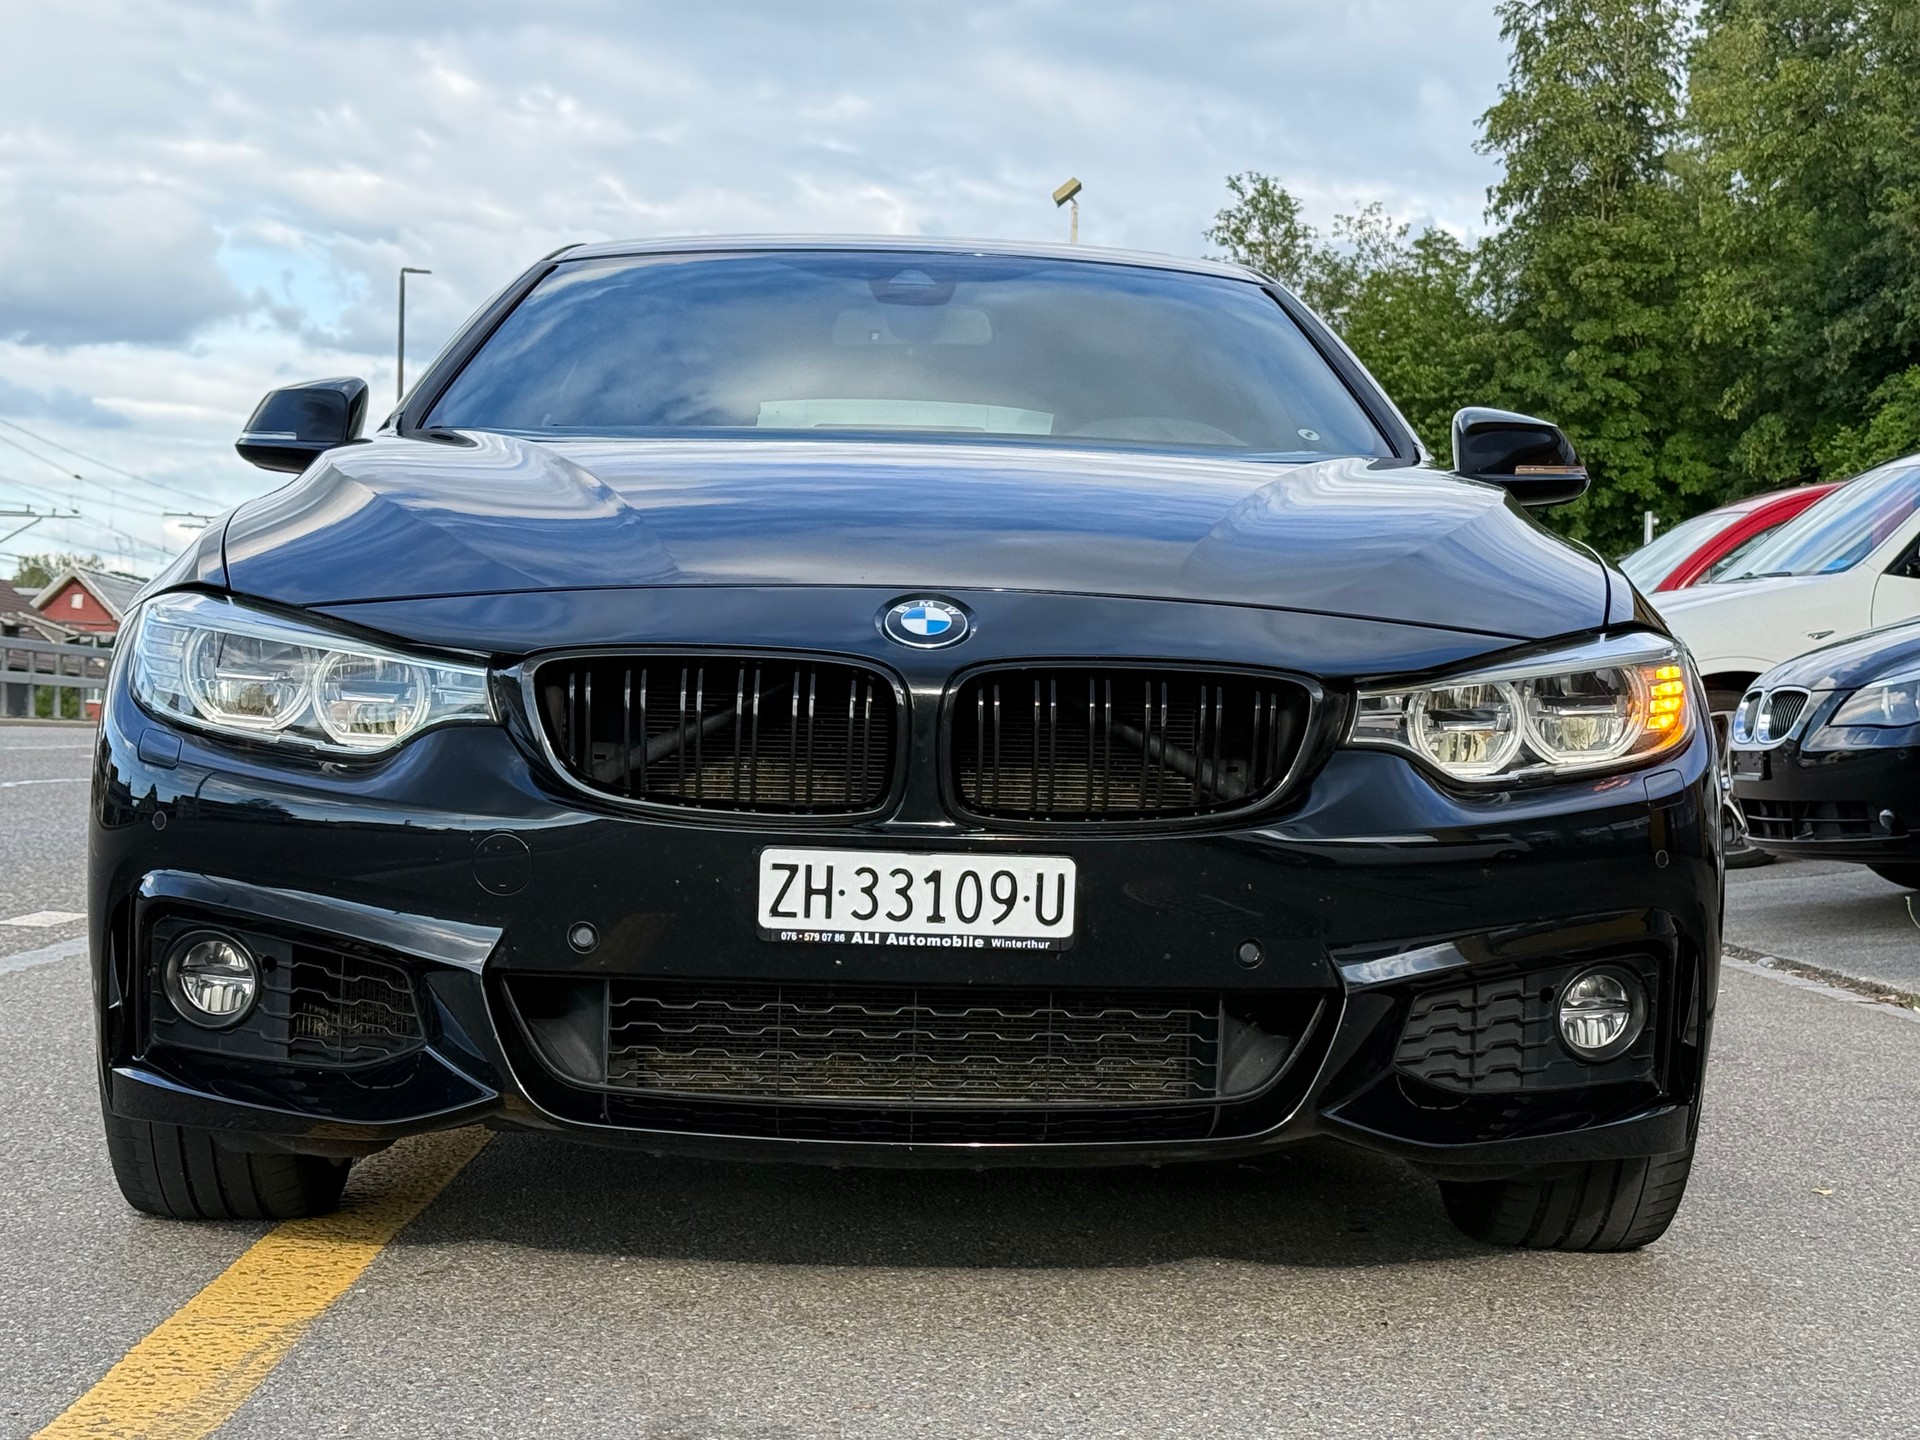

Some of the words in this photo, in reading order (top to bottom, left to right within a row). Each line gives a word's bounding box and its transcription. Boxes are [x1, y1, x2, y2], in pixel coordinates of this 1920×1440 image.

[894, 600, 961, 615] BMW
[821, 932, 833, 942] 07
[850, 931, 880, 945] ALI
[885, 933, 985, 948] Automobile
[991, 938, 1051, 950] Winterthur
